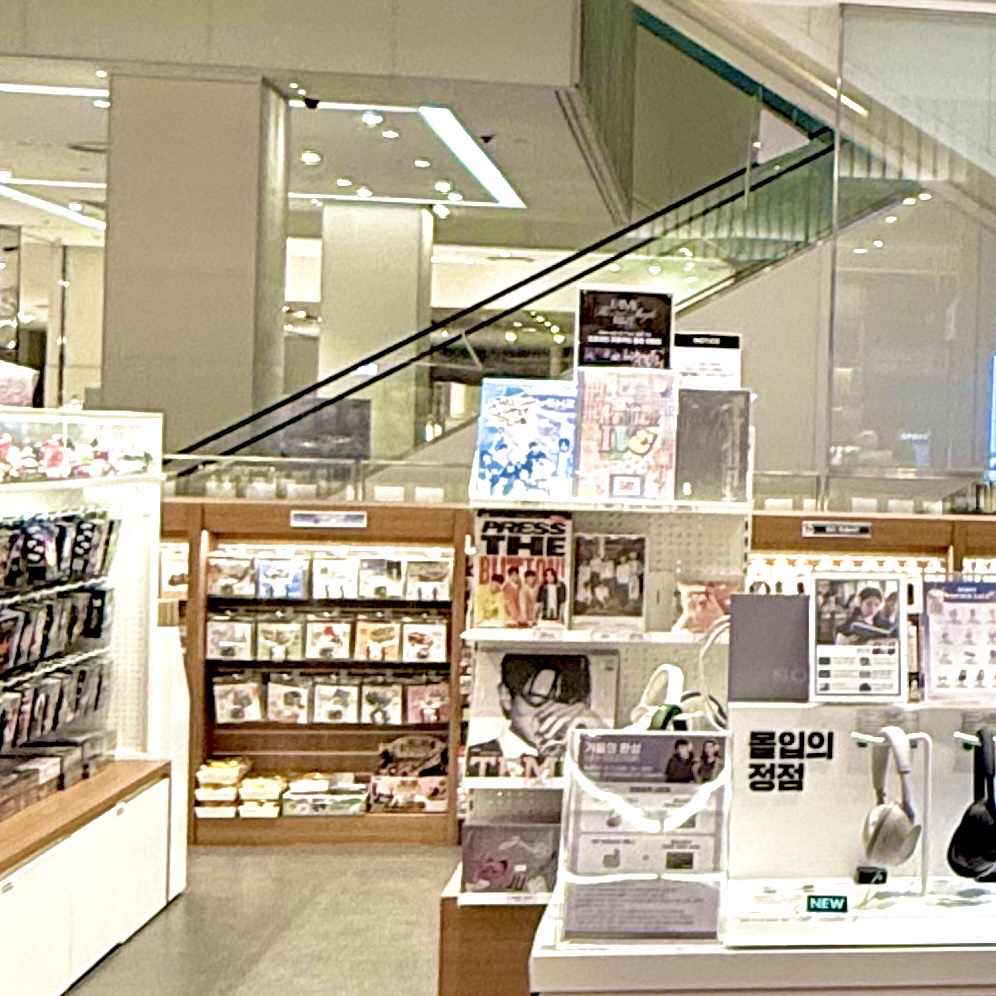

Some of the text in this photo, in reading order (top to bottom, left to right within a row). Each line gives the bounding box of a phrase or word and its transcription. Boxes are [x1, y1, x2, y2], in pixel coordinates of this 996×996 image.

[481, 520, 568, 535] PRESS
[480, 535, 567, 556] THE
[748, 731, 834, 760] 몰입의
[748, 763, 804, 792] 정점
[809, 896, 845, 911] NEW
